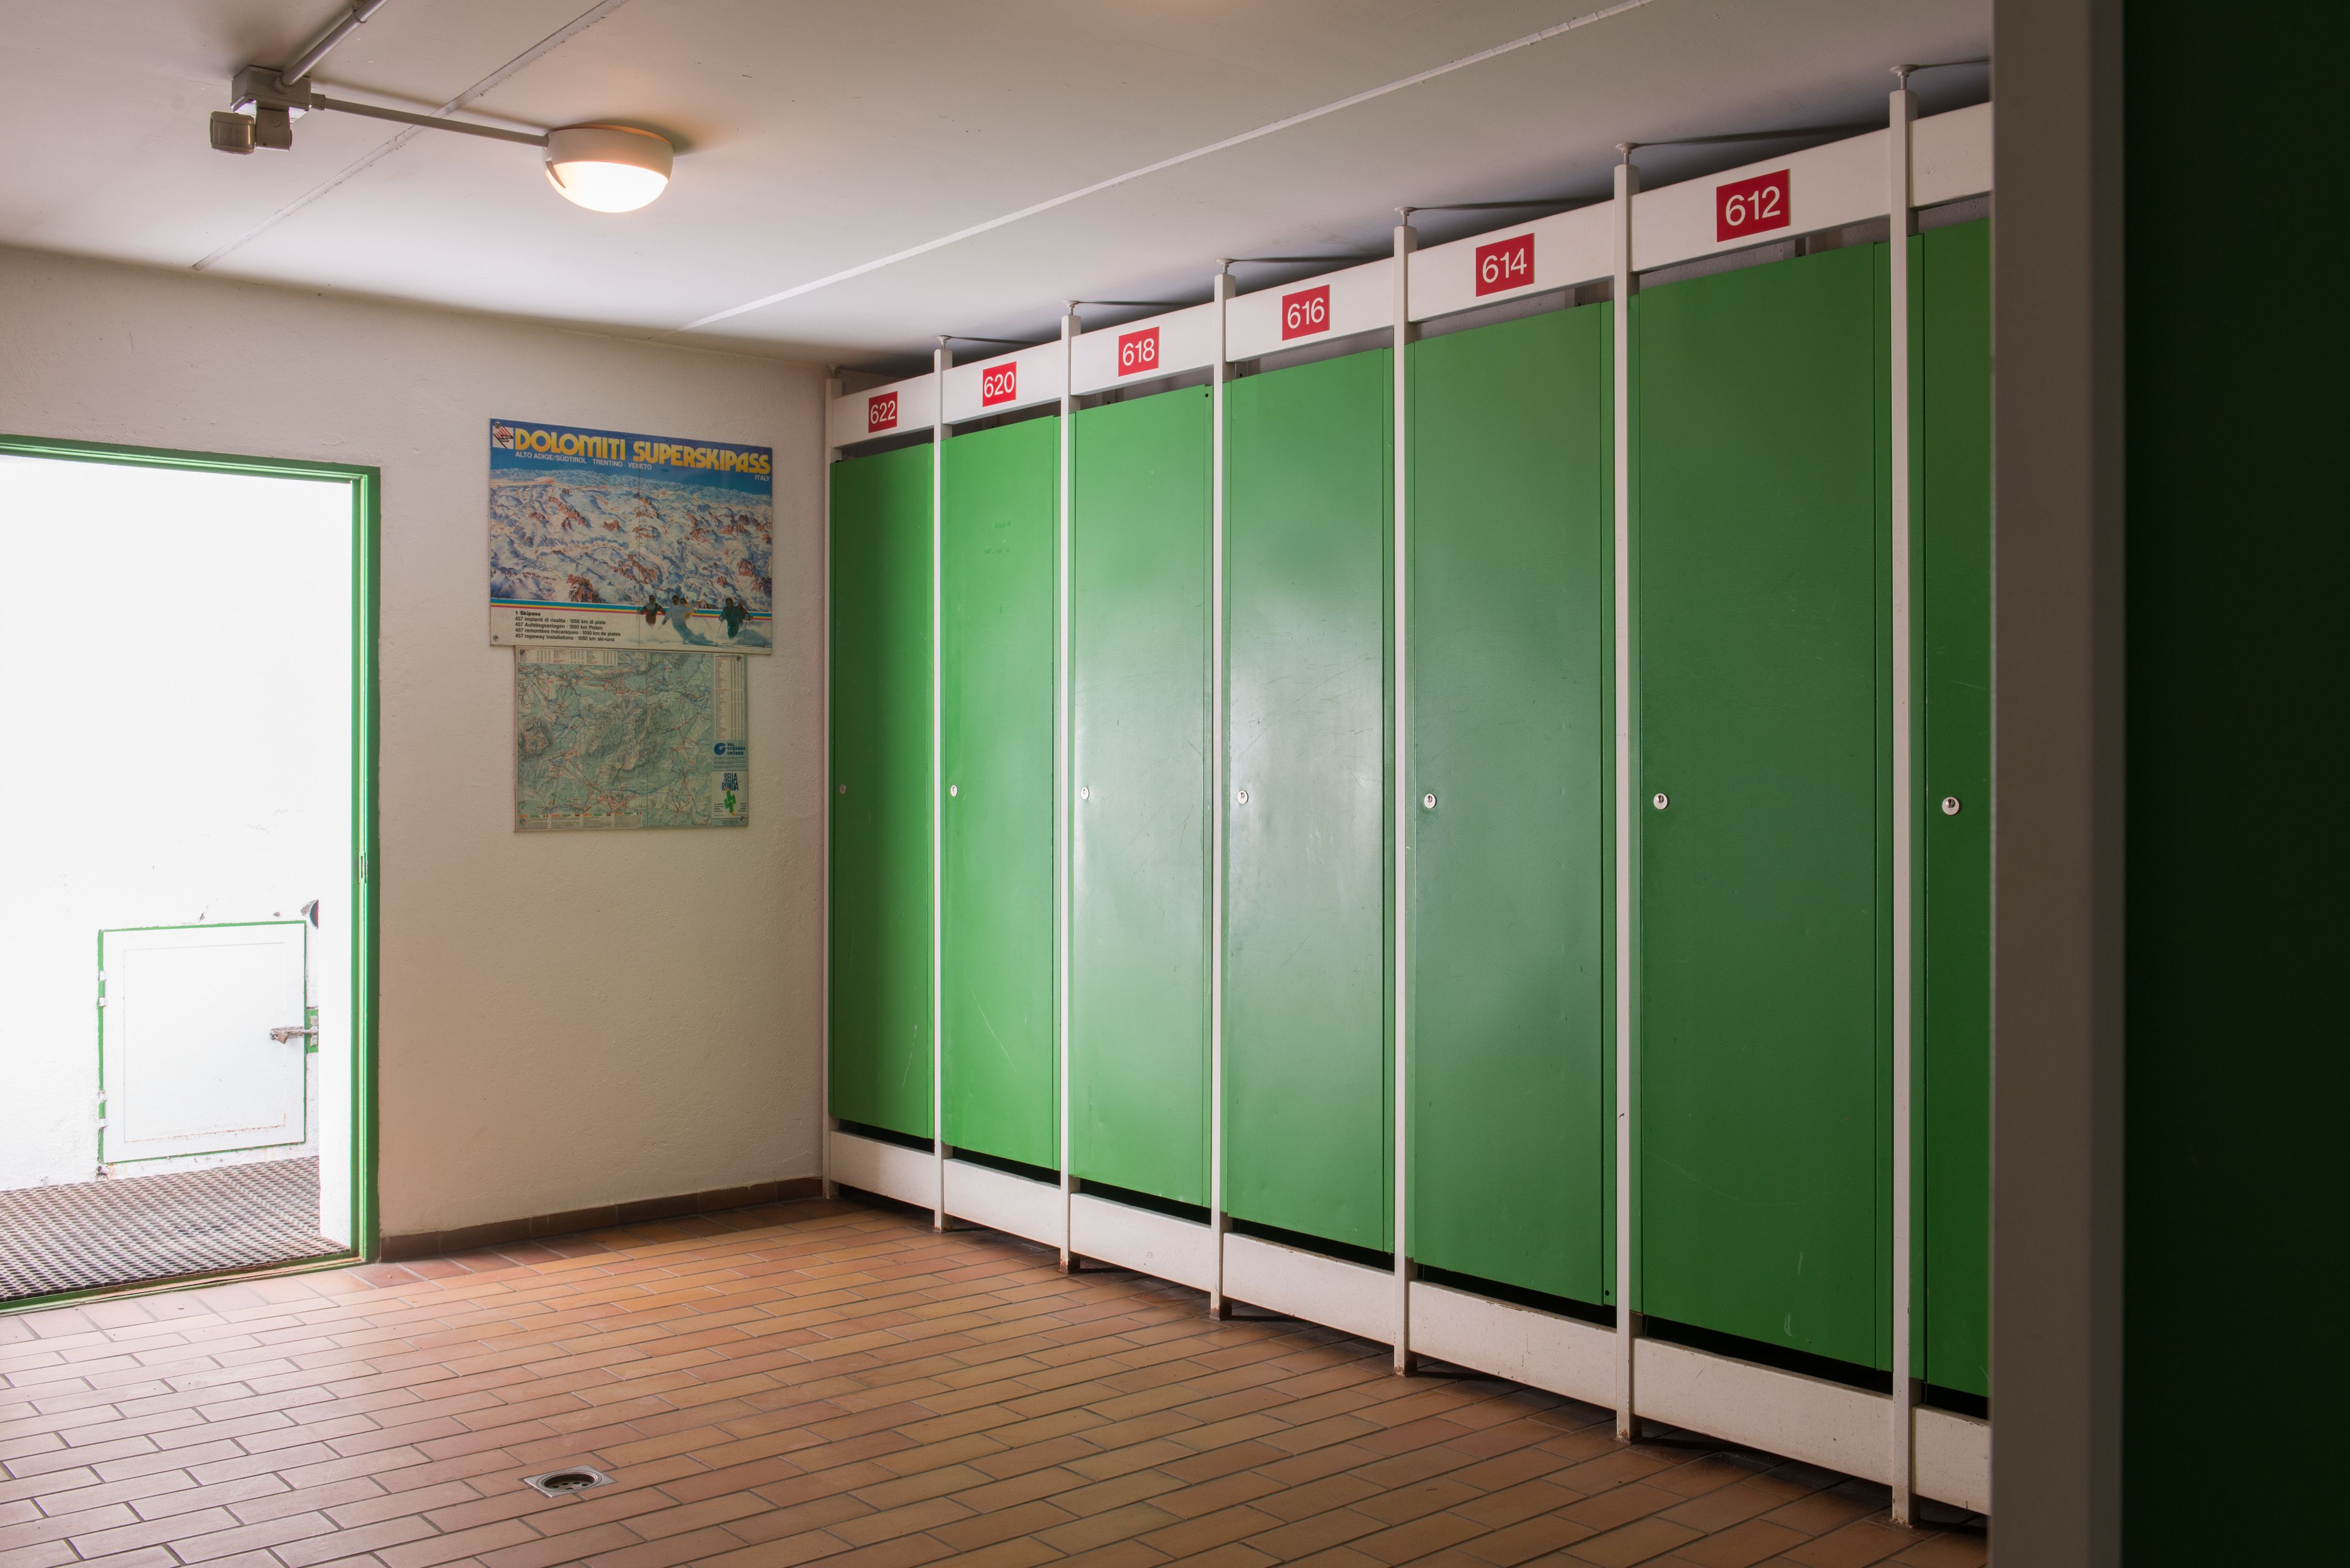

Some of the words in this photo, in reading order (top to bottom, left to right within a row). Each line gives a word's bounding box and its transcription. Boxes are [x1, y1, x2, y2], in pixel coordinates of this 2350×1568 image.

[1725, 186, 1780, 226] 612
[1482, 248, 1527, 283] 614
[1287, 297, 1325, 329] 616
[1122, 338, 1155, 367] 618
[983, 371, 1015, 398] 620
[870, 400, 896, 424] 622
[515, 428, 626, 460] DOLOMITI
[633, 441, 770, 475] SUPERSKIPASS
[534, 453, 587, 464] ADIGE/SÜDTIROL
[722, 782, 739, 791] RONDA
[724, 772, 738, 782] SELLA
